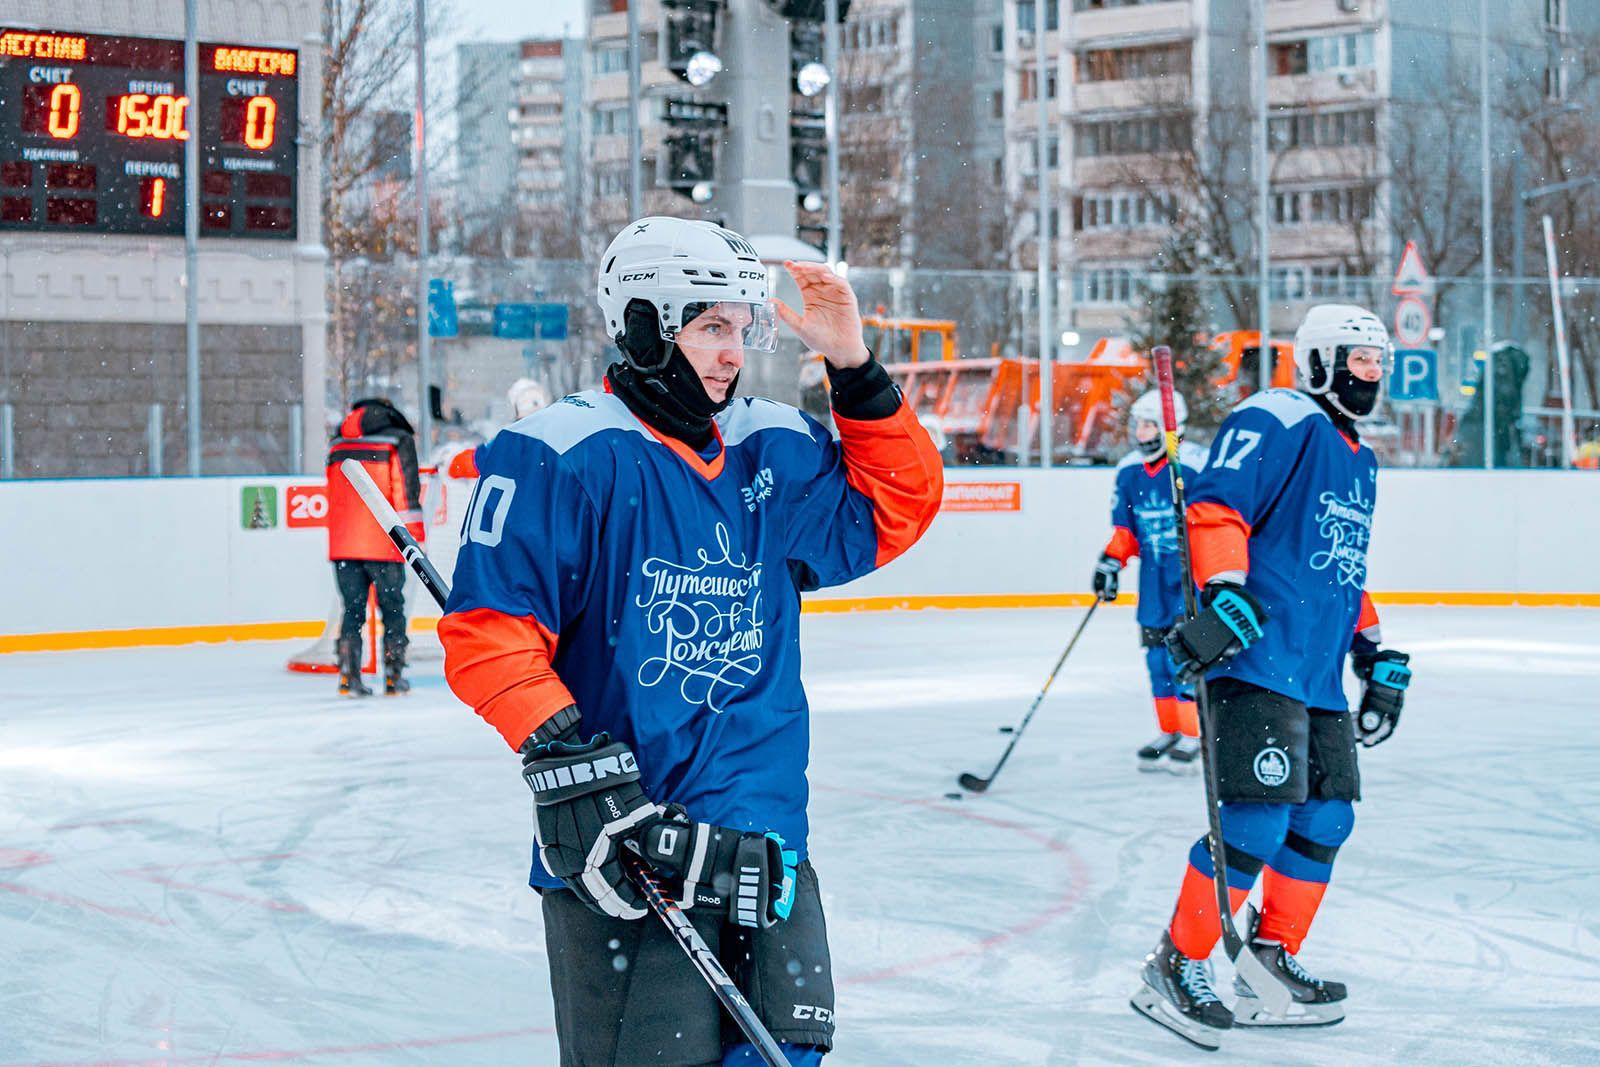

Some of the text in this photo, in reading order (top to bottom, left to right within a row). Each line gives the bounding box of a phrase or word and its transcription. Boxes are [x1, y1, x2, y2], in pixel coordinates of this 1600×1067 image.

[29, 66, 73, 83] СЧЕТ
[226, 79, 267, 96] СЧЕТ
[49, 83, 81, 139] 0
[117, 94, 190, 140] 15:00
[244, 96, 277, 149] 0
[125, 160, 180, 178] ПЕРИОД
[151, 178, 165, 218] 1
[622, 272, 656, 282] CCM
[737, 271, 766, 281] CCM
[1402, 355, 1429, 395] P
[1212, 428, 1262, 470] 17
[604, 796, 622, 818] goat
